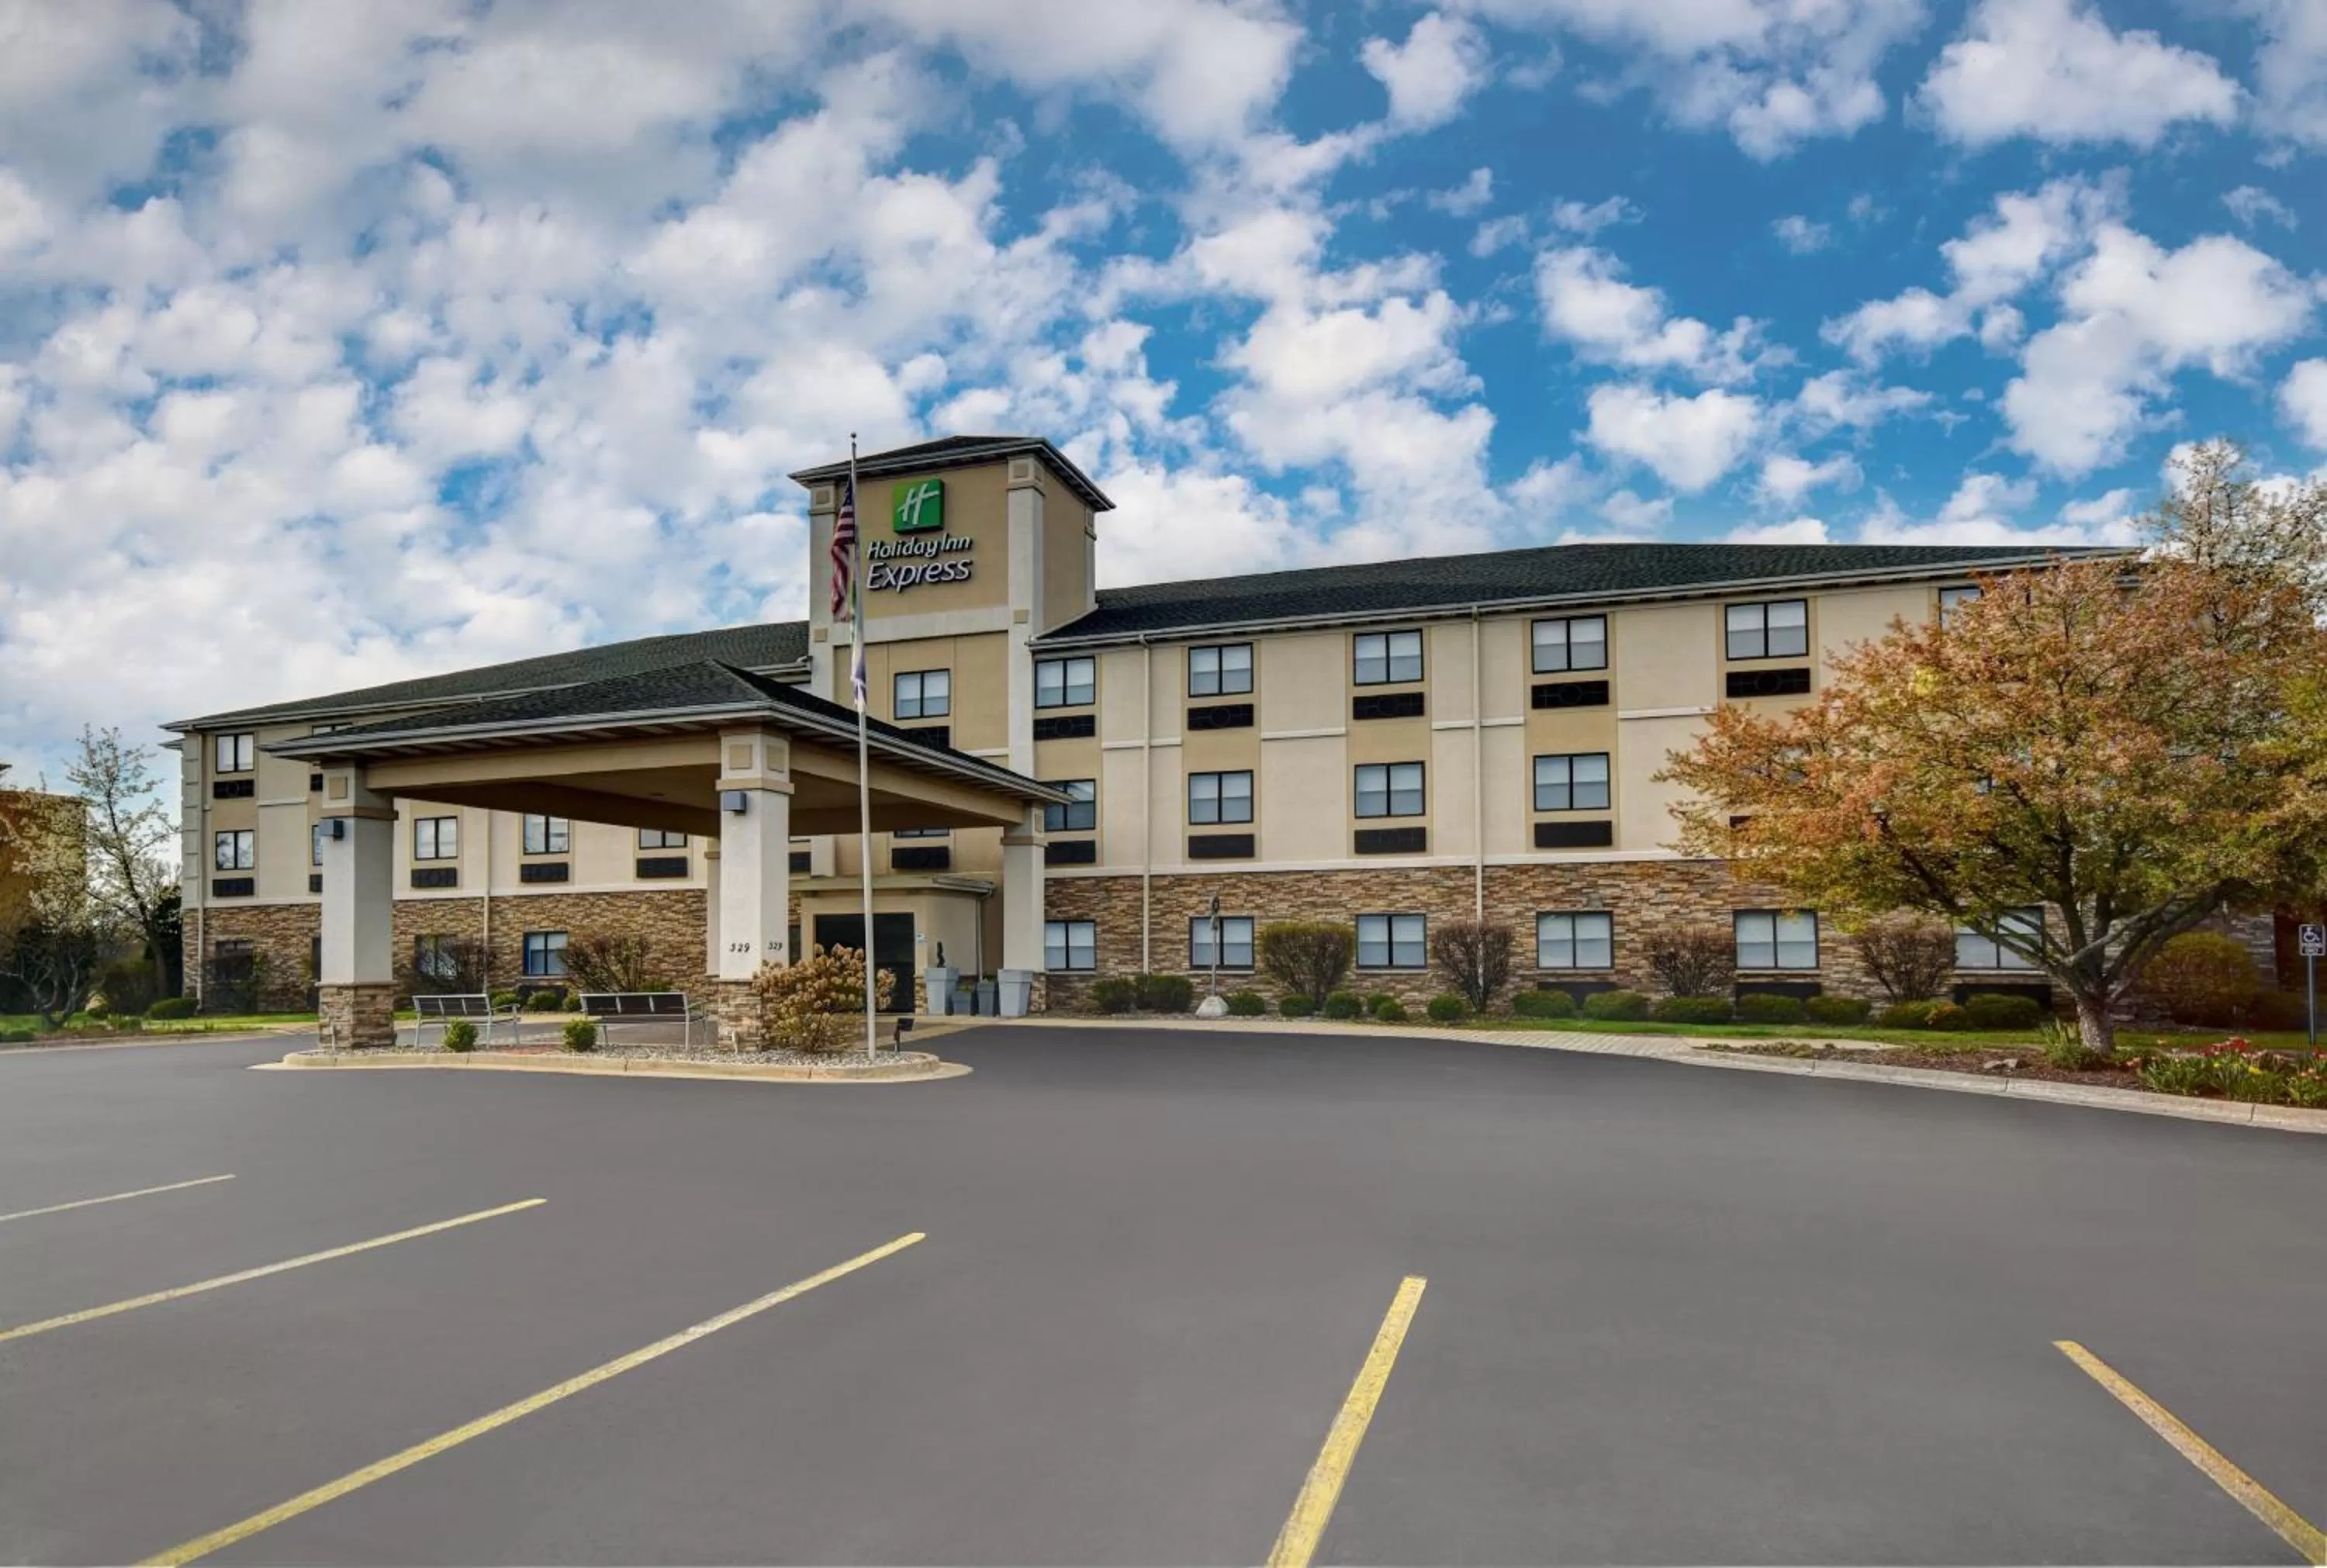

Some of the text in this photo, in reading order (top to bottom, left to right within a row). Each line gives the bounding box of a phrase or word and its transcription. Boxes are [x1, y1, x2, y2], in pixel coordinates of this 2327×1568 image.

[866, 533, 971, 559] Holiday Inn
[866, 559, 971, 593] Express
